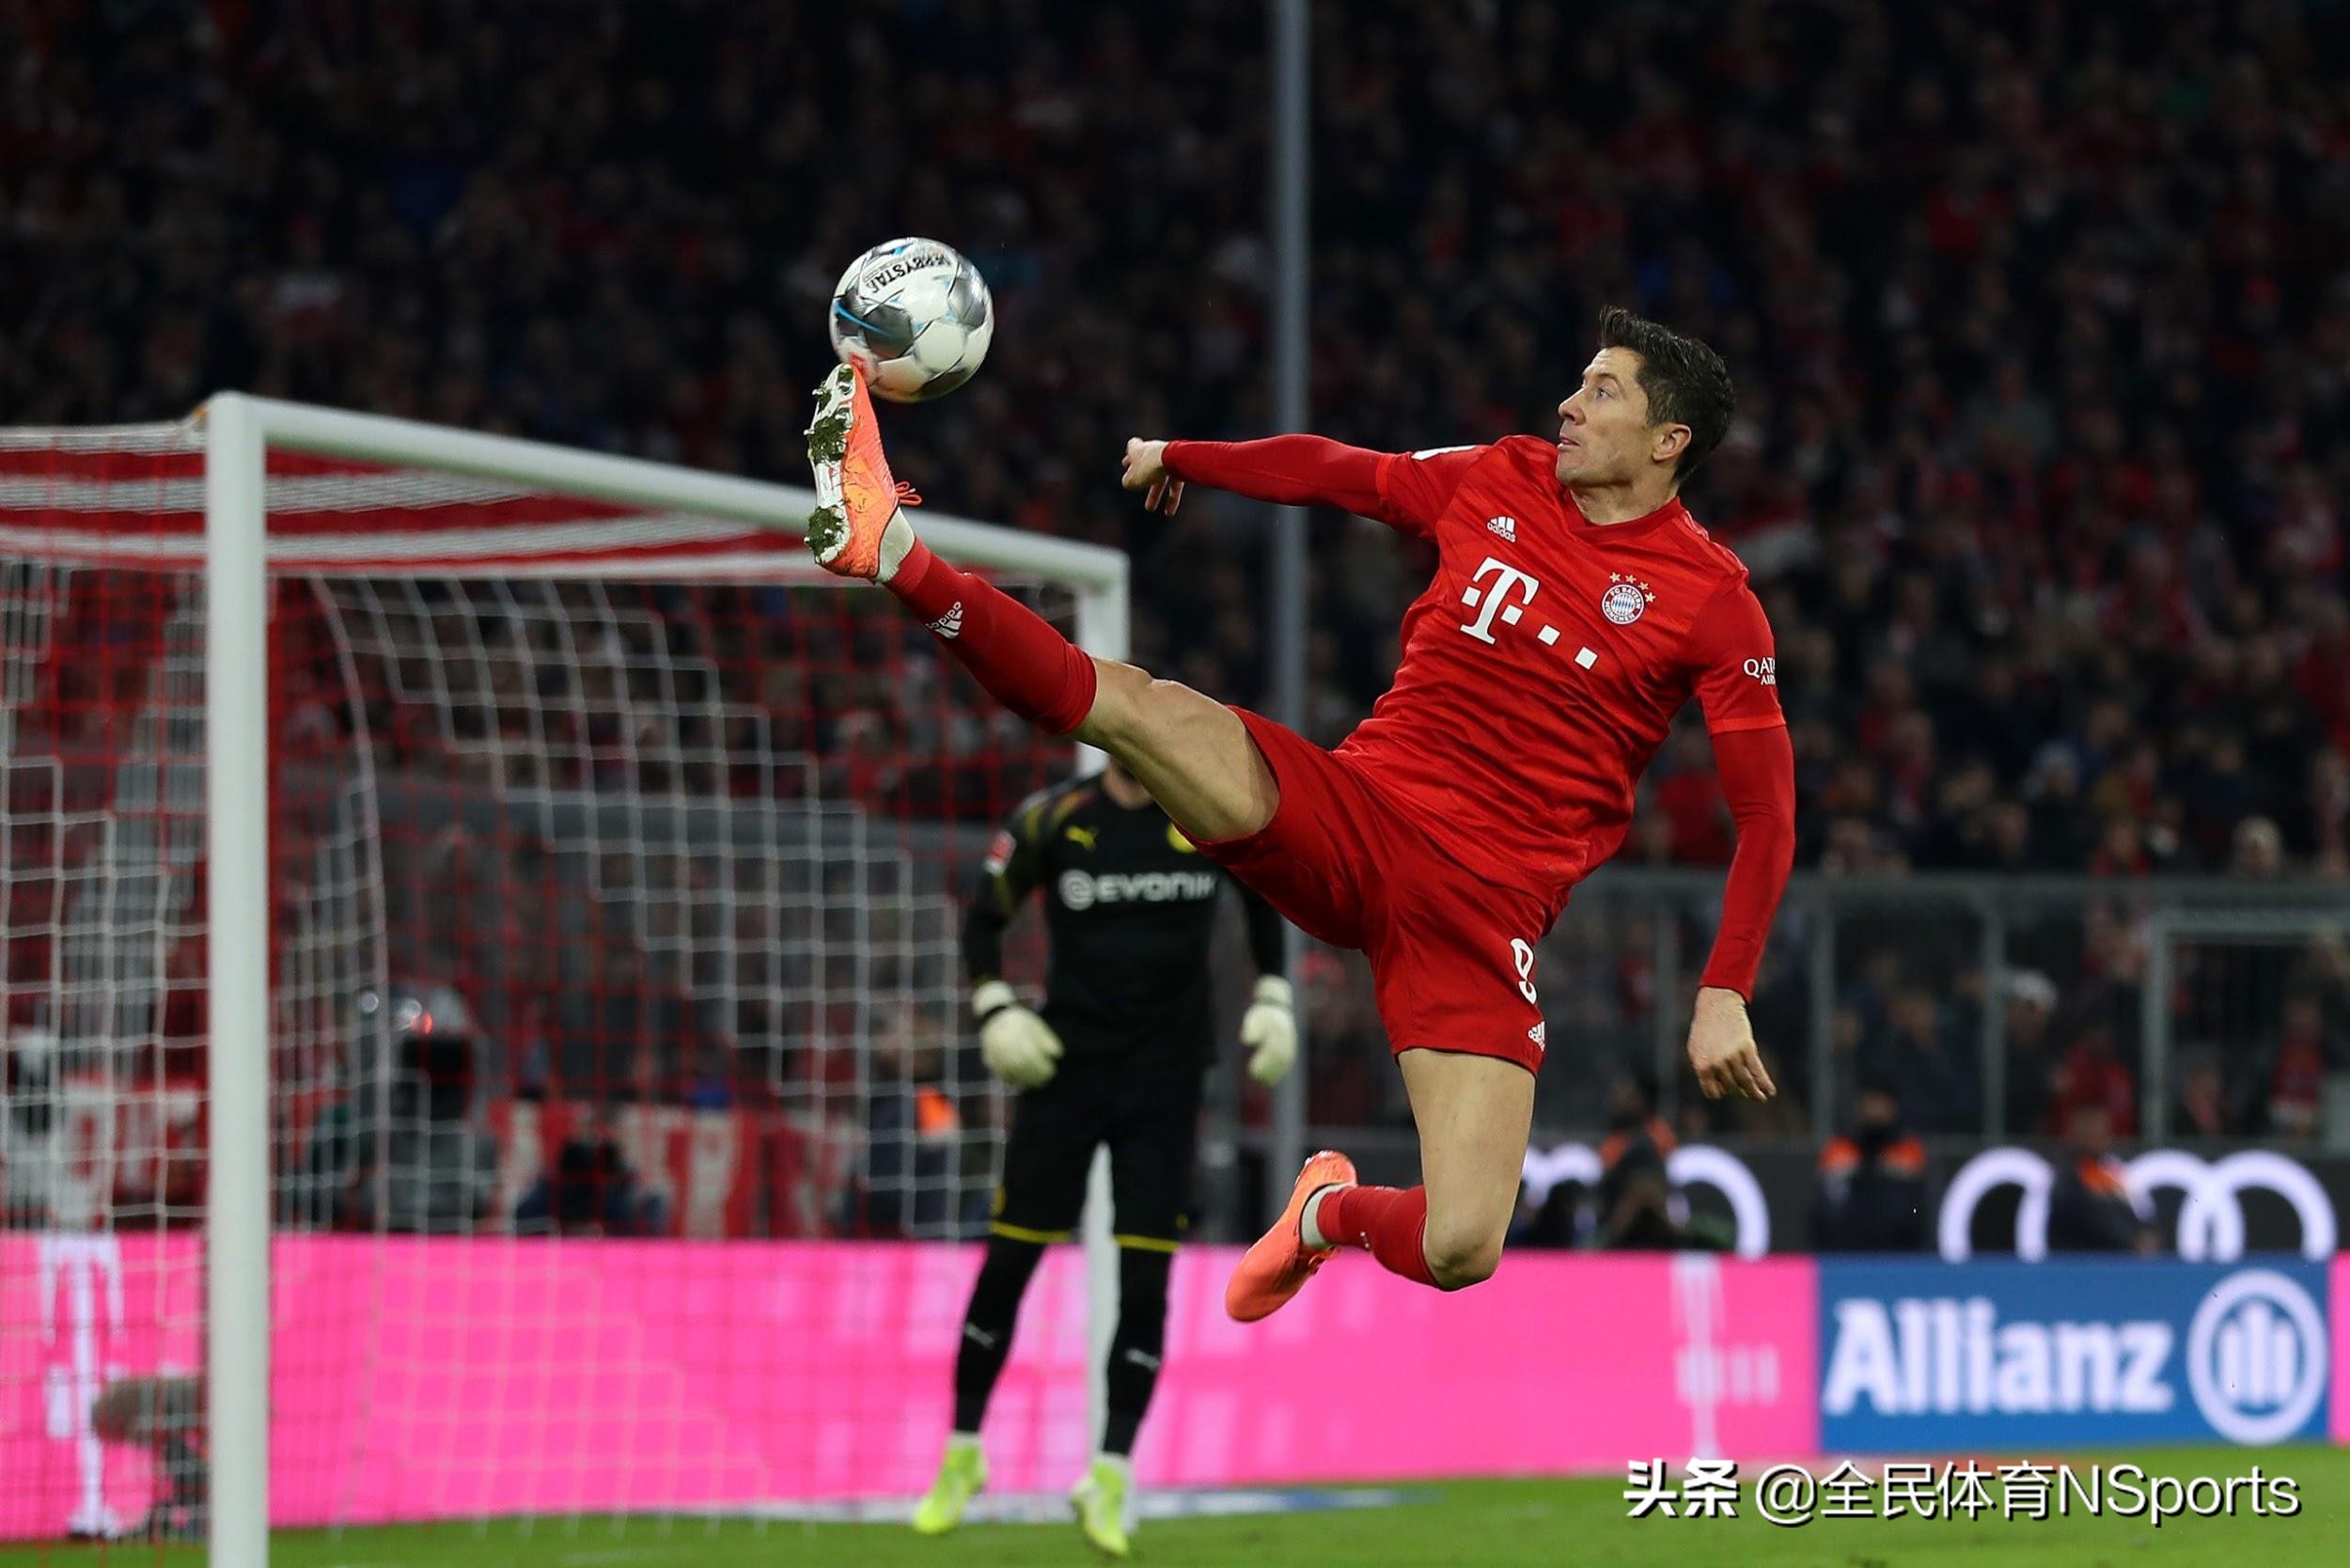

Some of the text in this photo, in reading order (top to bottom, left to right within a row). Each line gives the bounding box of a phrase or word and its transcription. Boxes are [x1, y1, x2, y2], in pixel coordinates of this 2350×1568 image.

[1486, 522, 1516, 542] adidas
[1511, 938, 1537, 1005] 9
[1825, 1297, 2173, 1414] Allianz
